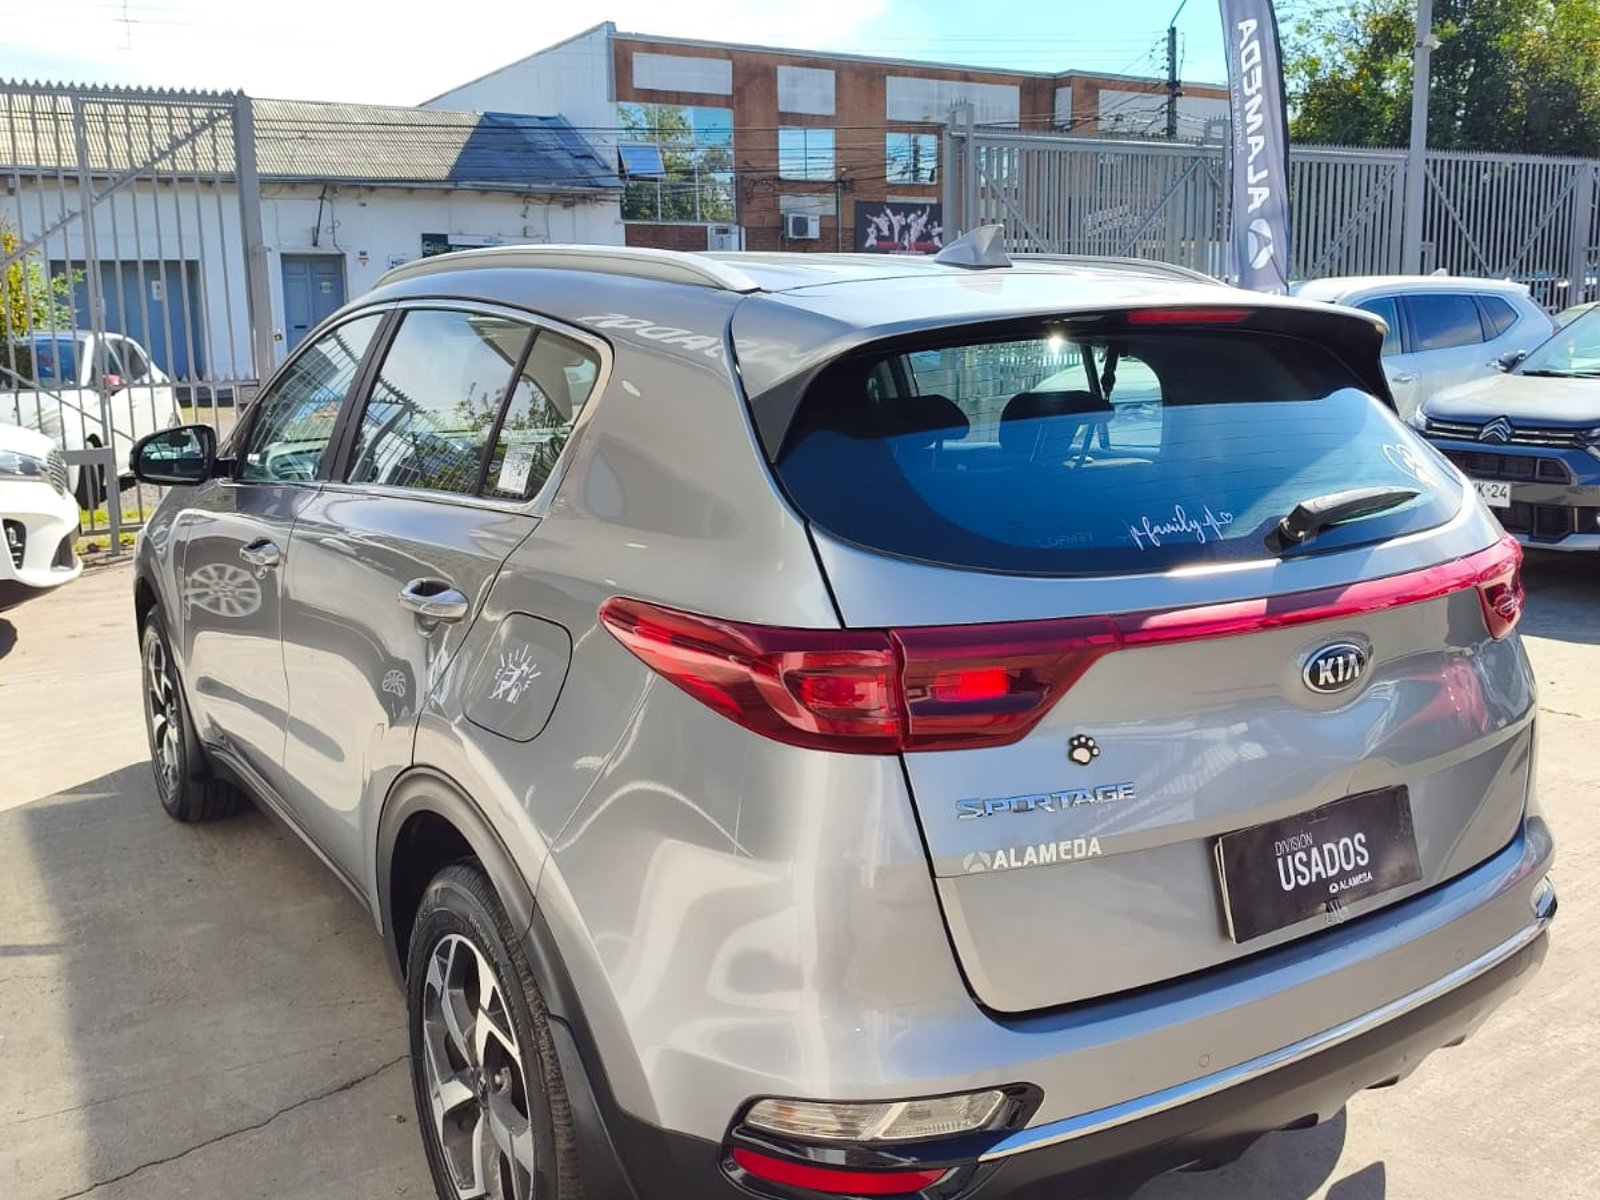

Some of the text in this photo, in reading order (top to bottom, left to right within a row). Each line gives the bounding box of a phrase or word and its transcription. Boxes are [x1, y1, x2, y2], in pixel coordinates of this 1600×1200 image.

[1317, 654, 1360, 686] KIA
[956, 782, 1137, 820] SPORTAGE
[993, 836, 1102, 870] ALAMEDA
[1274, 830, 1313, 857] DIVISIÓN
[1277, 832, 1370, 891] USADOS
[1339, 871, 1373, 892] ALAMEDA
